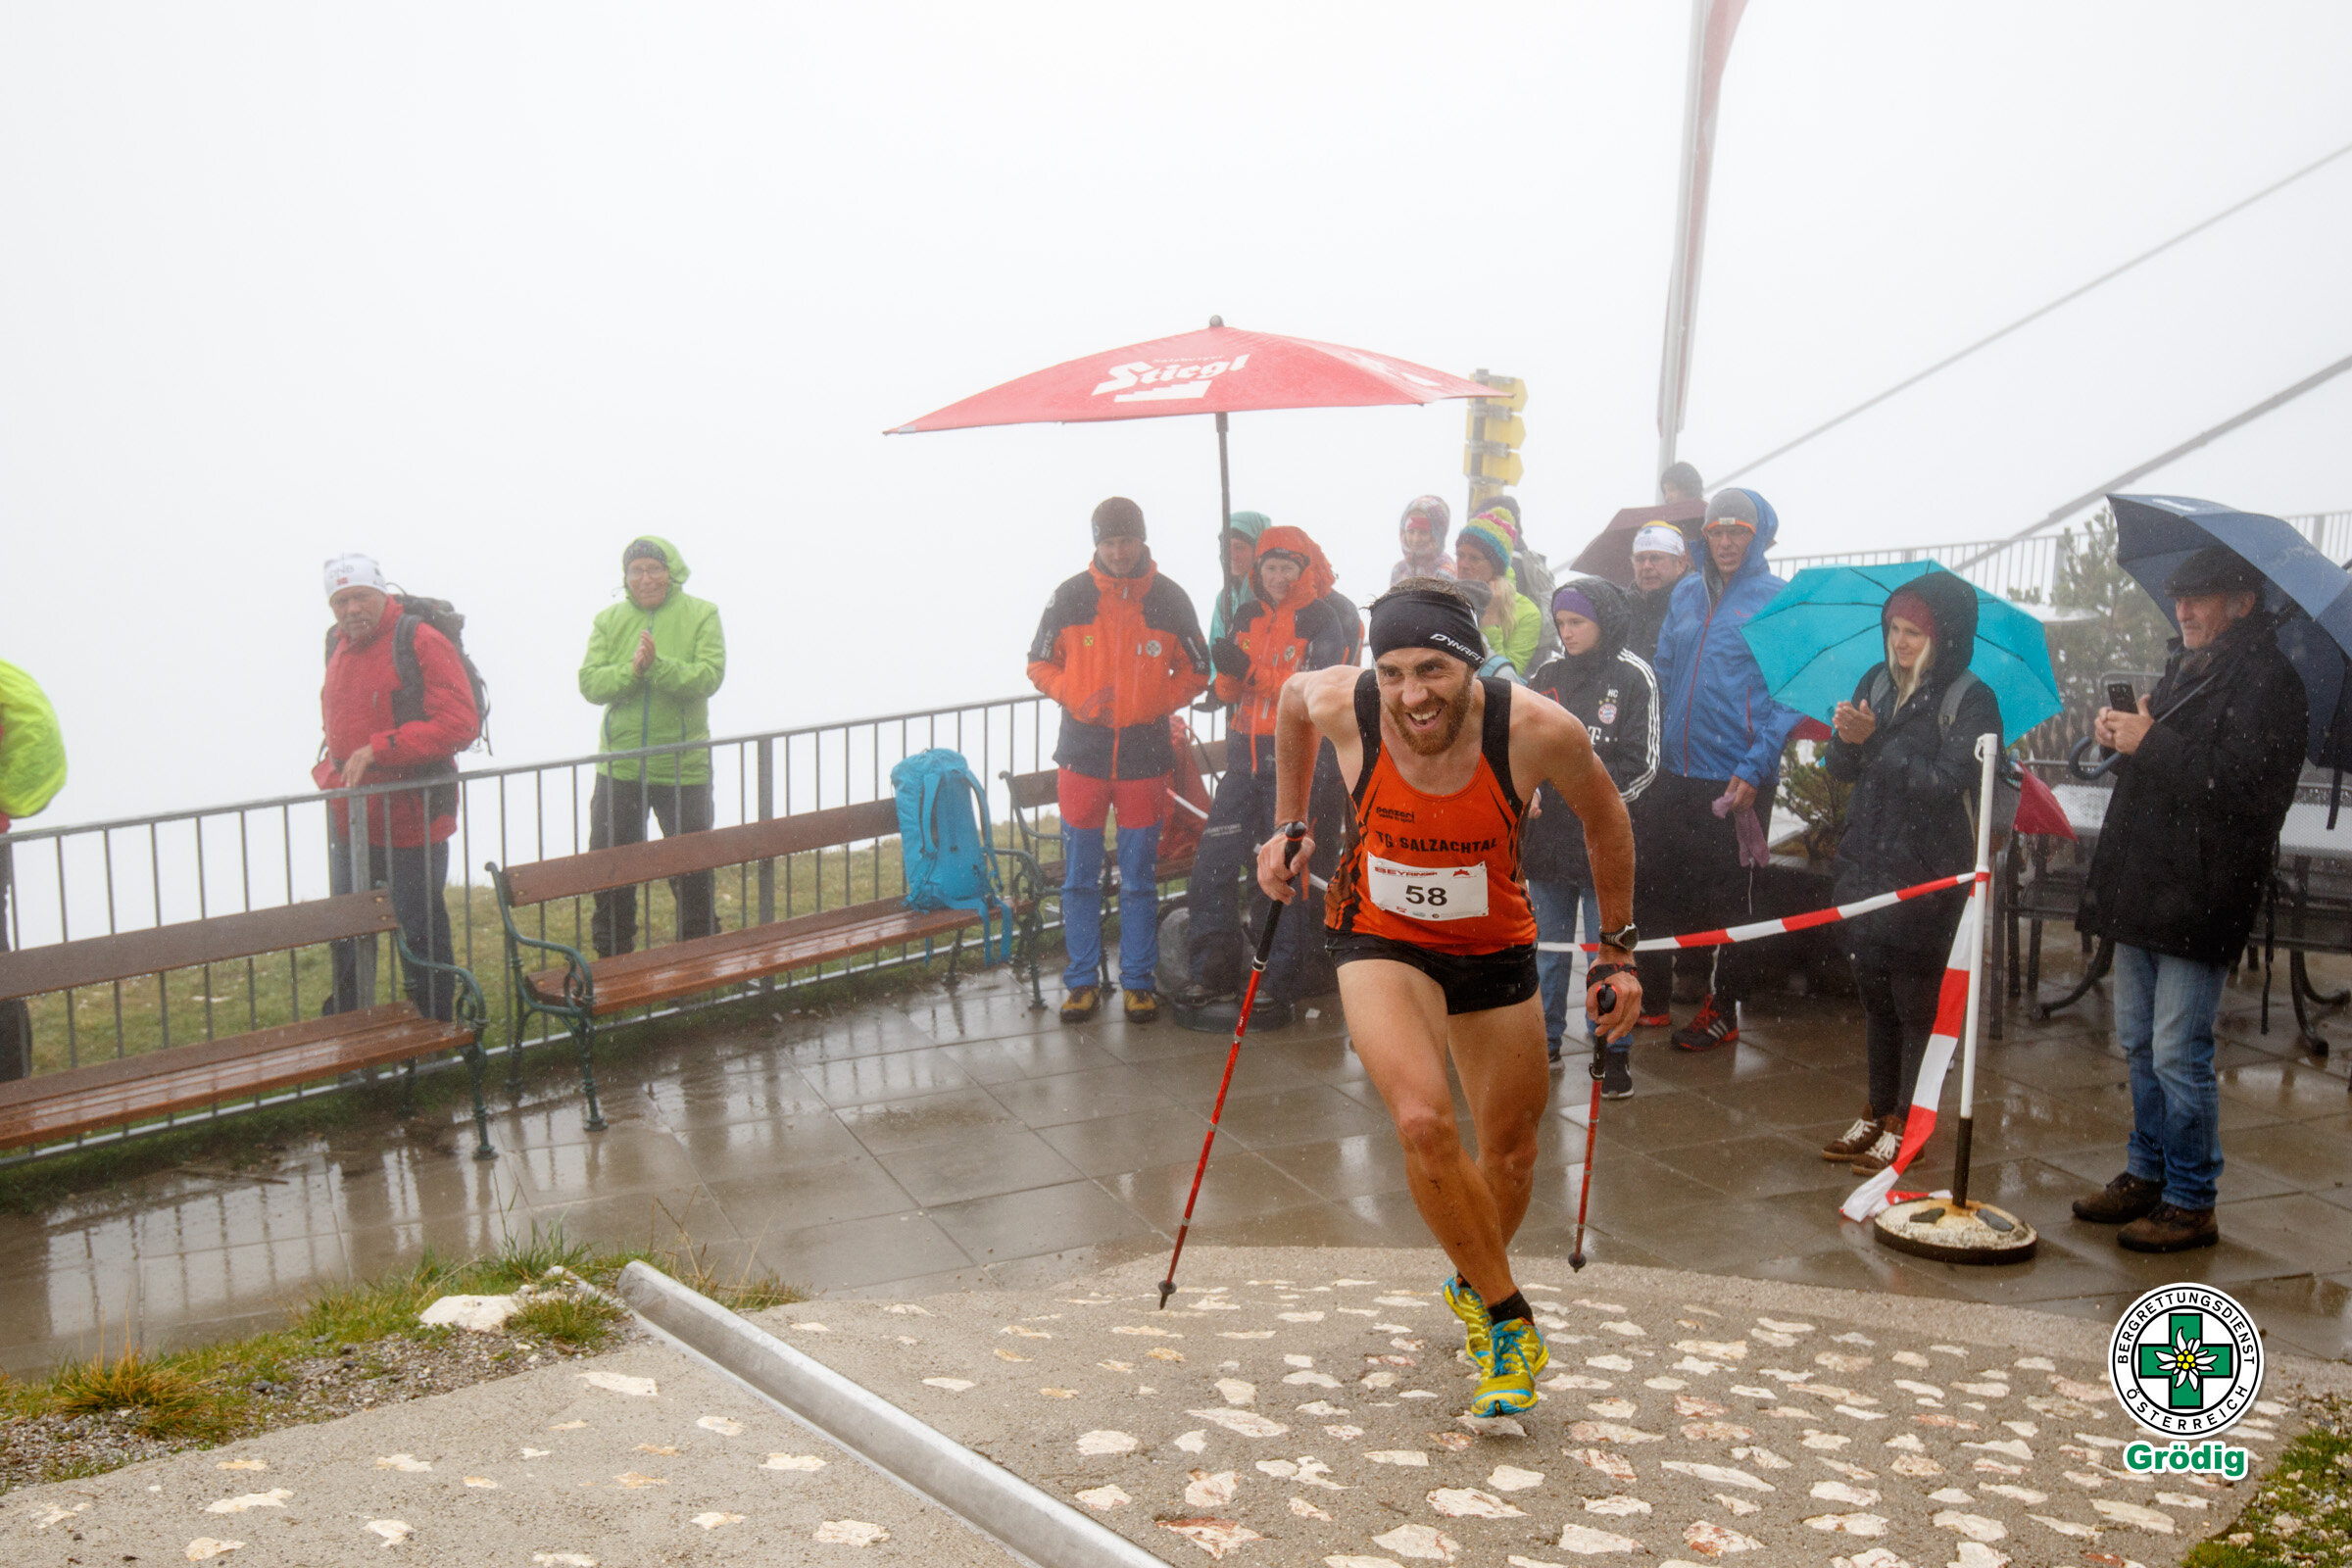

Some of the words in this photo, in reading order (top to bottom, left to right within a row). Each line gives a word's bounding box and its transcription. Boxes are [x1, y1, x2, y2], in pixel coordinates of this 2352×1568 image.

[1091, 354, 1250, 396] Stiegl
[1430, 633, 1486, 664] DYNAFIT
[1375, 830, 1395, 849] TG
[1405, 885, 1448, 906] 58
